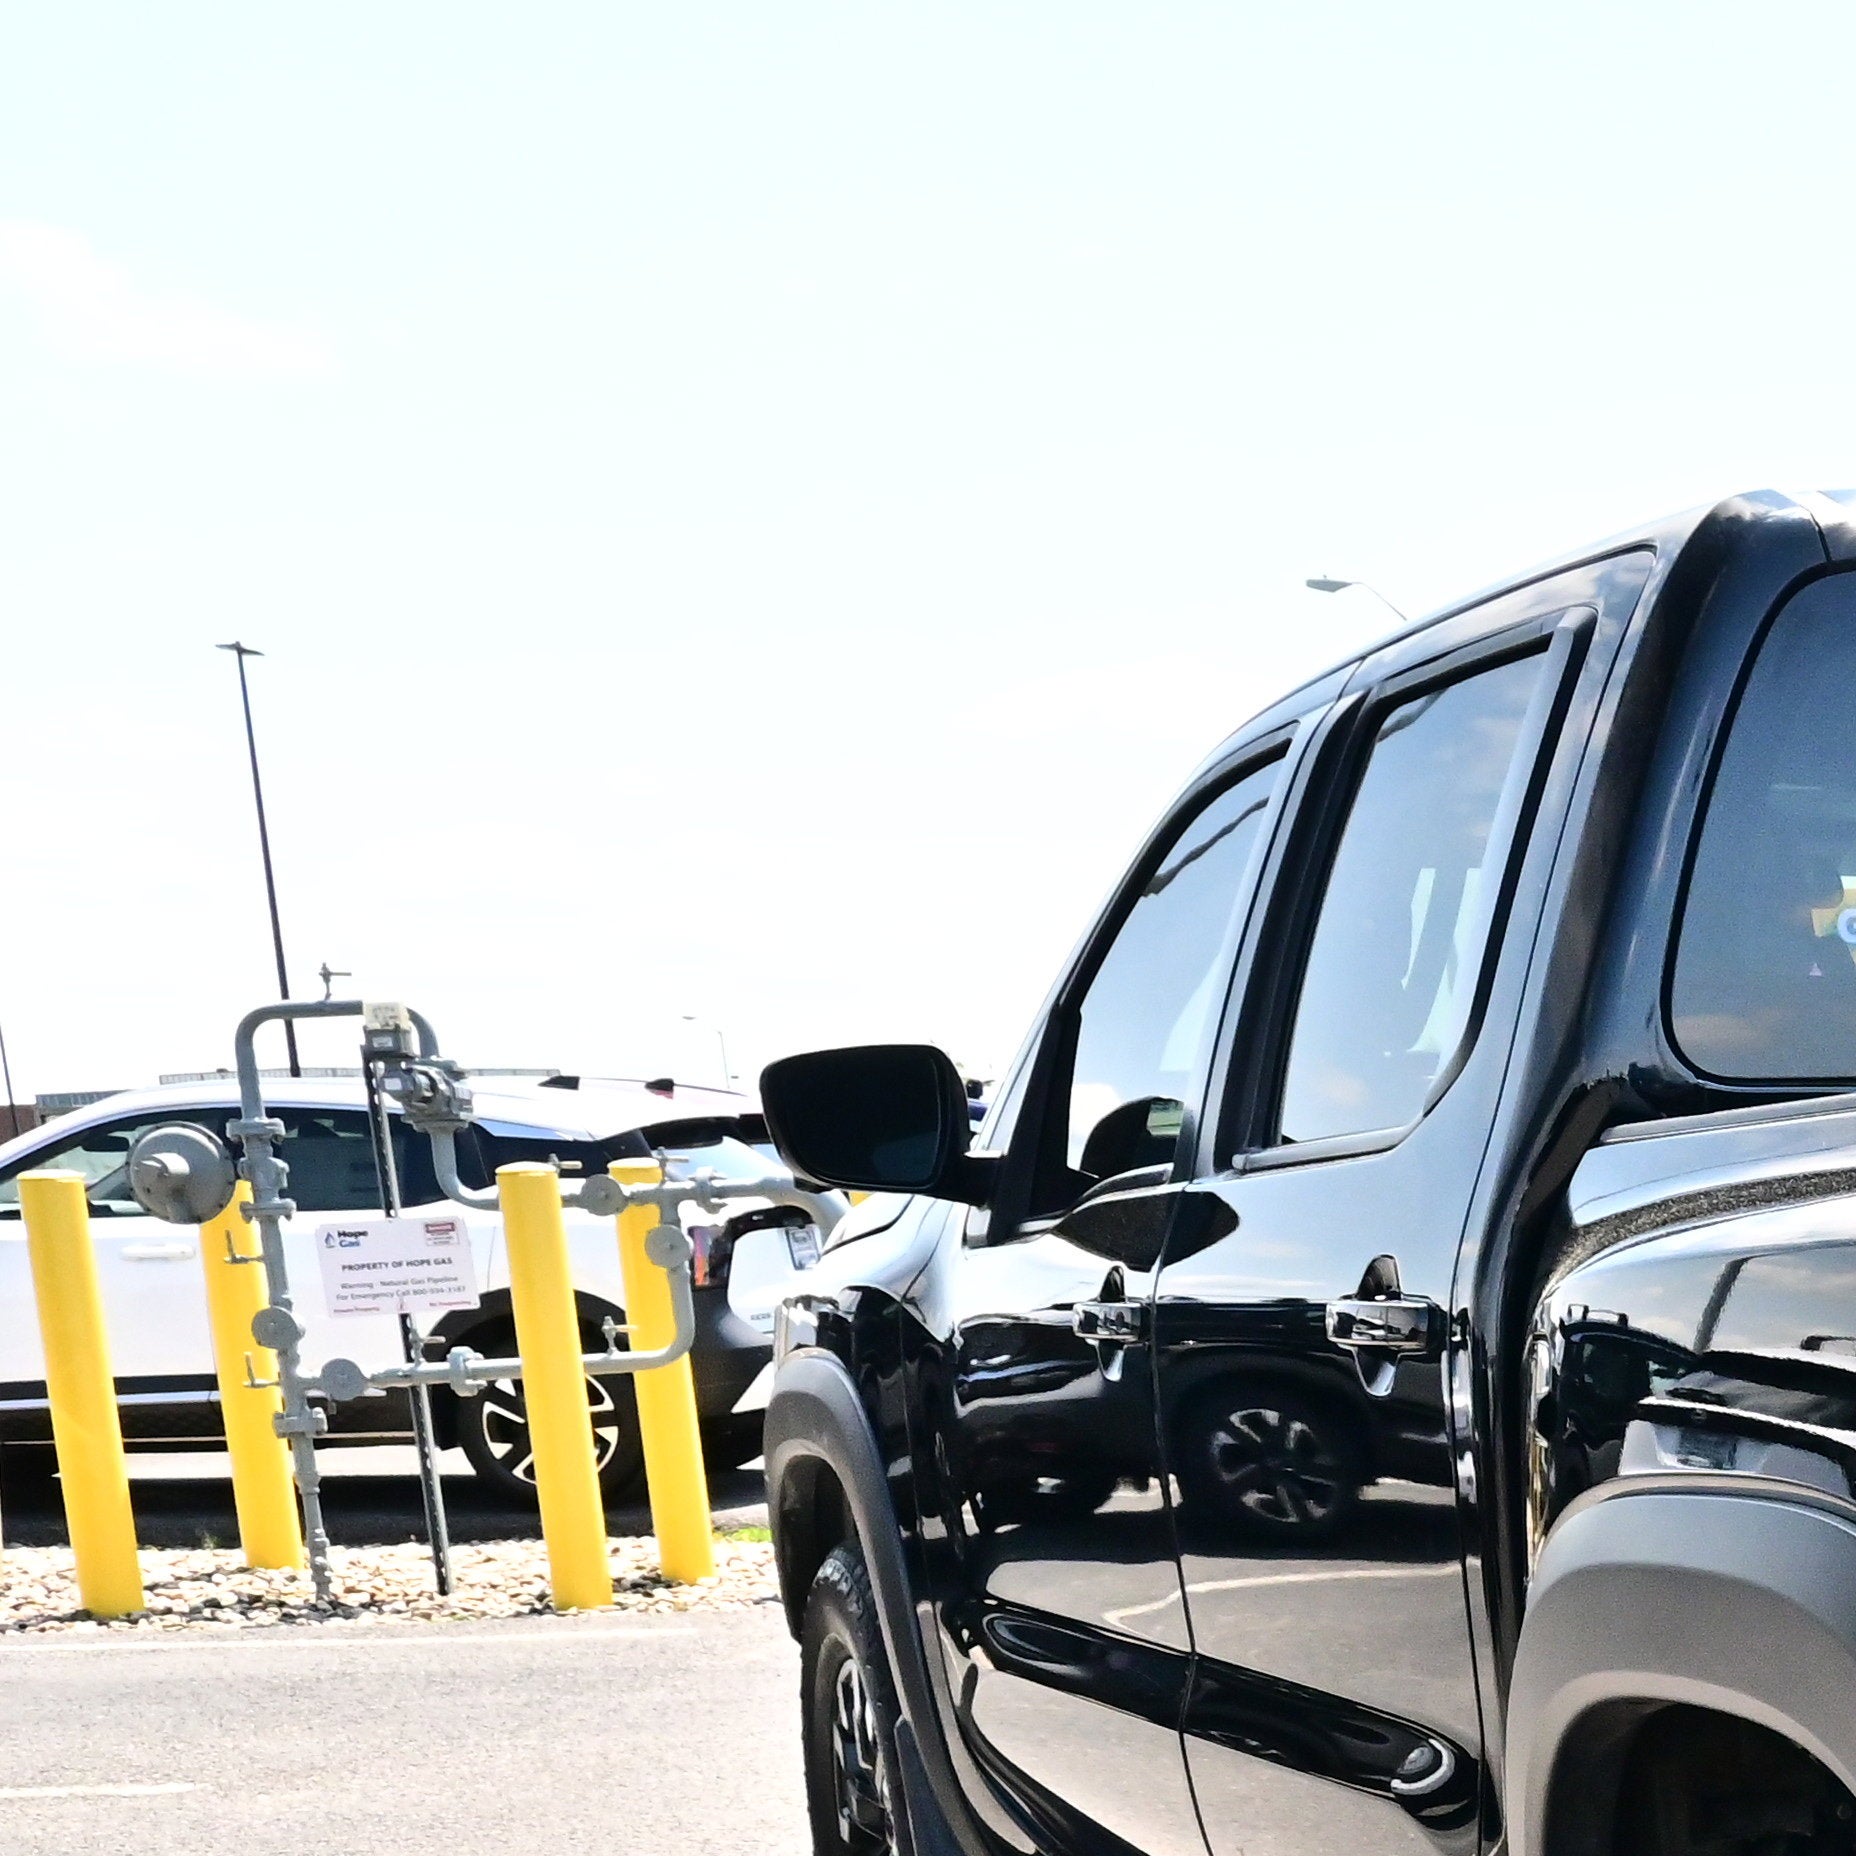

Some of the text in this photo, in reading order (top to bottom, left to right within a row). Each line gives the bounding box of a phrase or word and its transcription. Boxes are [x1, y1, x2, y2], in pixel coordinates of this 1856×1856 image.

[337, 1230, 368, 1239] Hope
[339, 1239, 360, 1247] Gas
[341, 1262, 389, 1271] PROPERTY
[405, 1259, 431, 1267] HOPE
[433, 1257, 453, 1265] GAS
